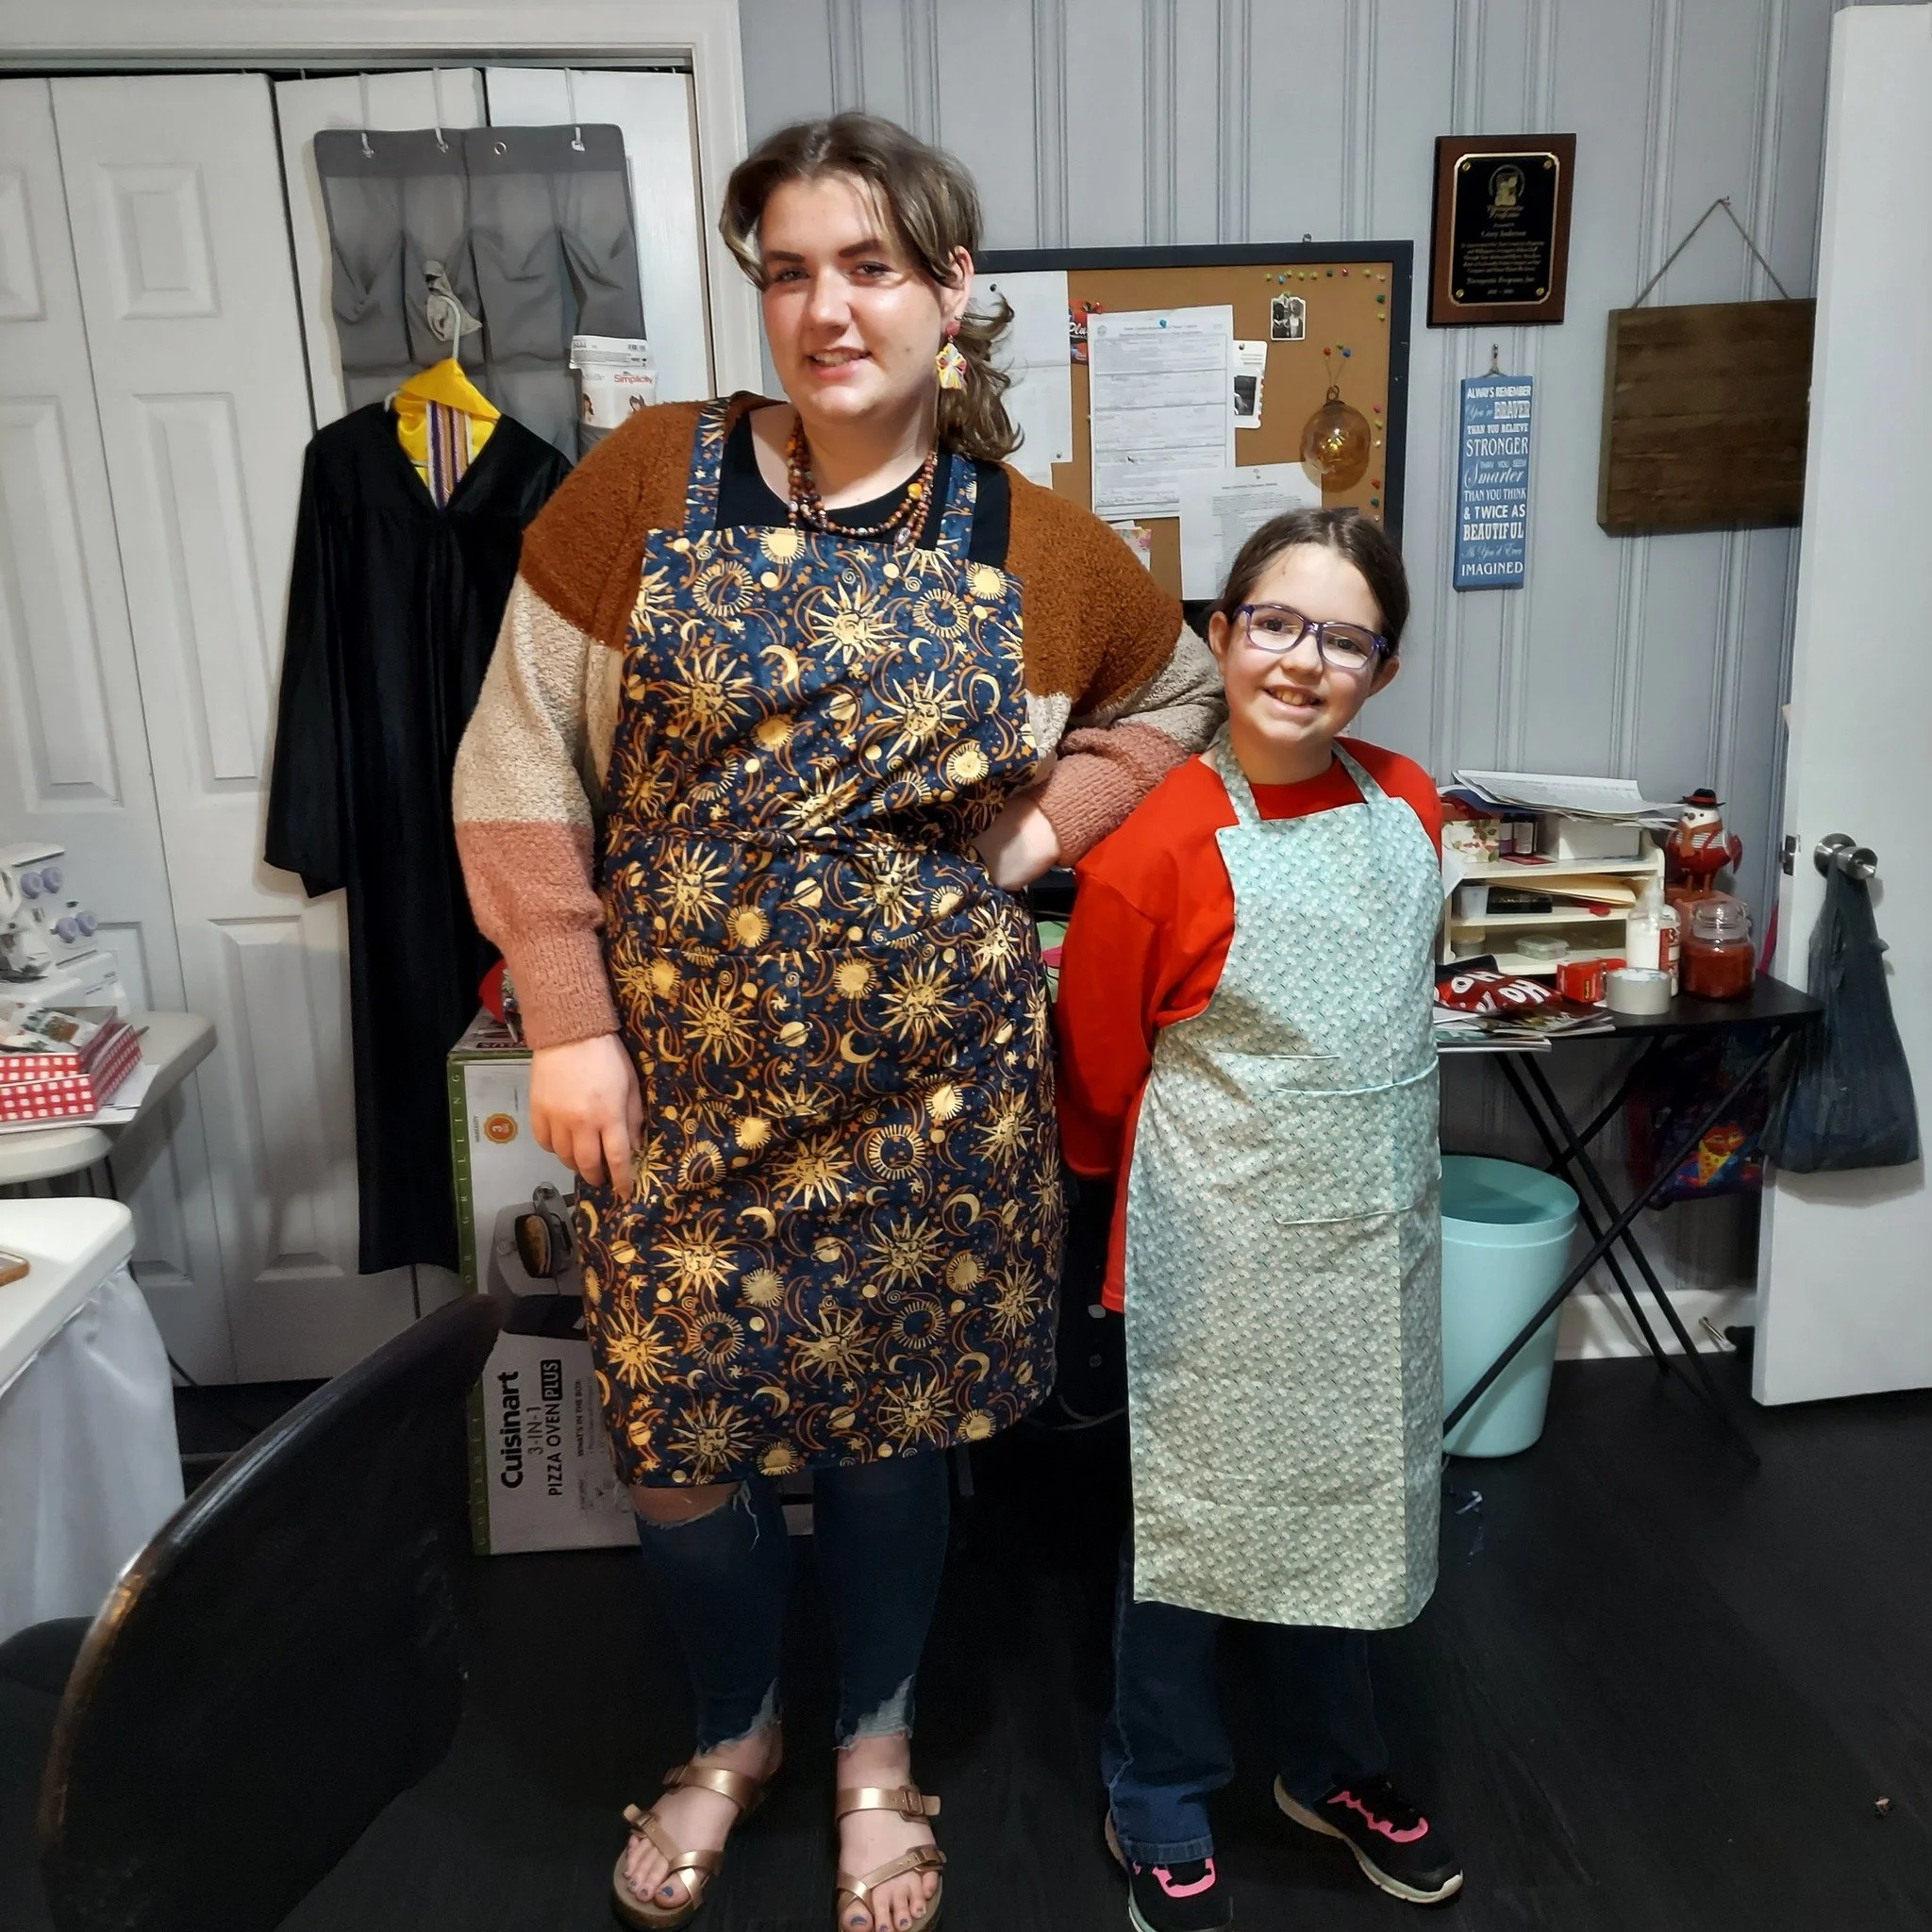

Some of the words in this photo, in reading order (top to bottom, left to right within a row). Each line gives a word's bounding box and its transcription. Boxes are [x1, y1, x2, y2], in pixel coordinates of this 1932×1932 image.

[1467, 387, 1494, 399] ALWAYS
[1495, 385, 1531, 397] REMEMBER
[1493, 400, 1530, 420] BRAVER
[1467, 425, 1486, 434] THAN
[1487, 424, 1499, 434] YOU
[1502, 423, 1528, 433] BELIEVE
[1466, 437, 1528, 457] STRONGER
[1464, 460, 1524, 489] Smarter
[1464, 490, 1484, 502] THAN
[1485, 489, 1502, 501] YOU
[1503, 488, 1526, 500] THINK
[1463, 507, 1471, 520] &
[1474, 505, 1508, 519] TWICE
[1511, 504, 1525, 518] AS
[1463, 522, 1524, 541] BEAUTIFUL
[1461, 561, 1524, 576] IMAGINED
[491, 1124, 503, 1133] 3
[451, 1074, 470, 1224] GRILLING
[542, 1362, 560, 1398] PLUS
[575, 1398, 583, 1413] THE
[497, 1372, 524, 1489] Cuisinart
[525, 1406, 543, 1455] 3-IN-1
[546, 1404, 561, 1447] OVEN
[575, 1416, 583, 1425] IN
[575, 1427, 584, 1457] WHAT'S
[547, 1453, 563, 1495] PIZZA
